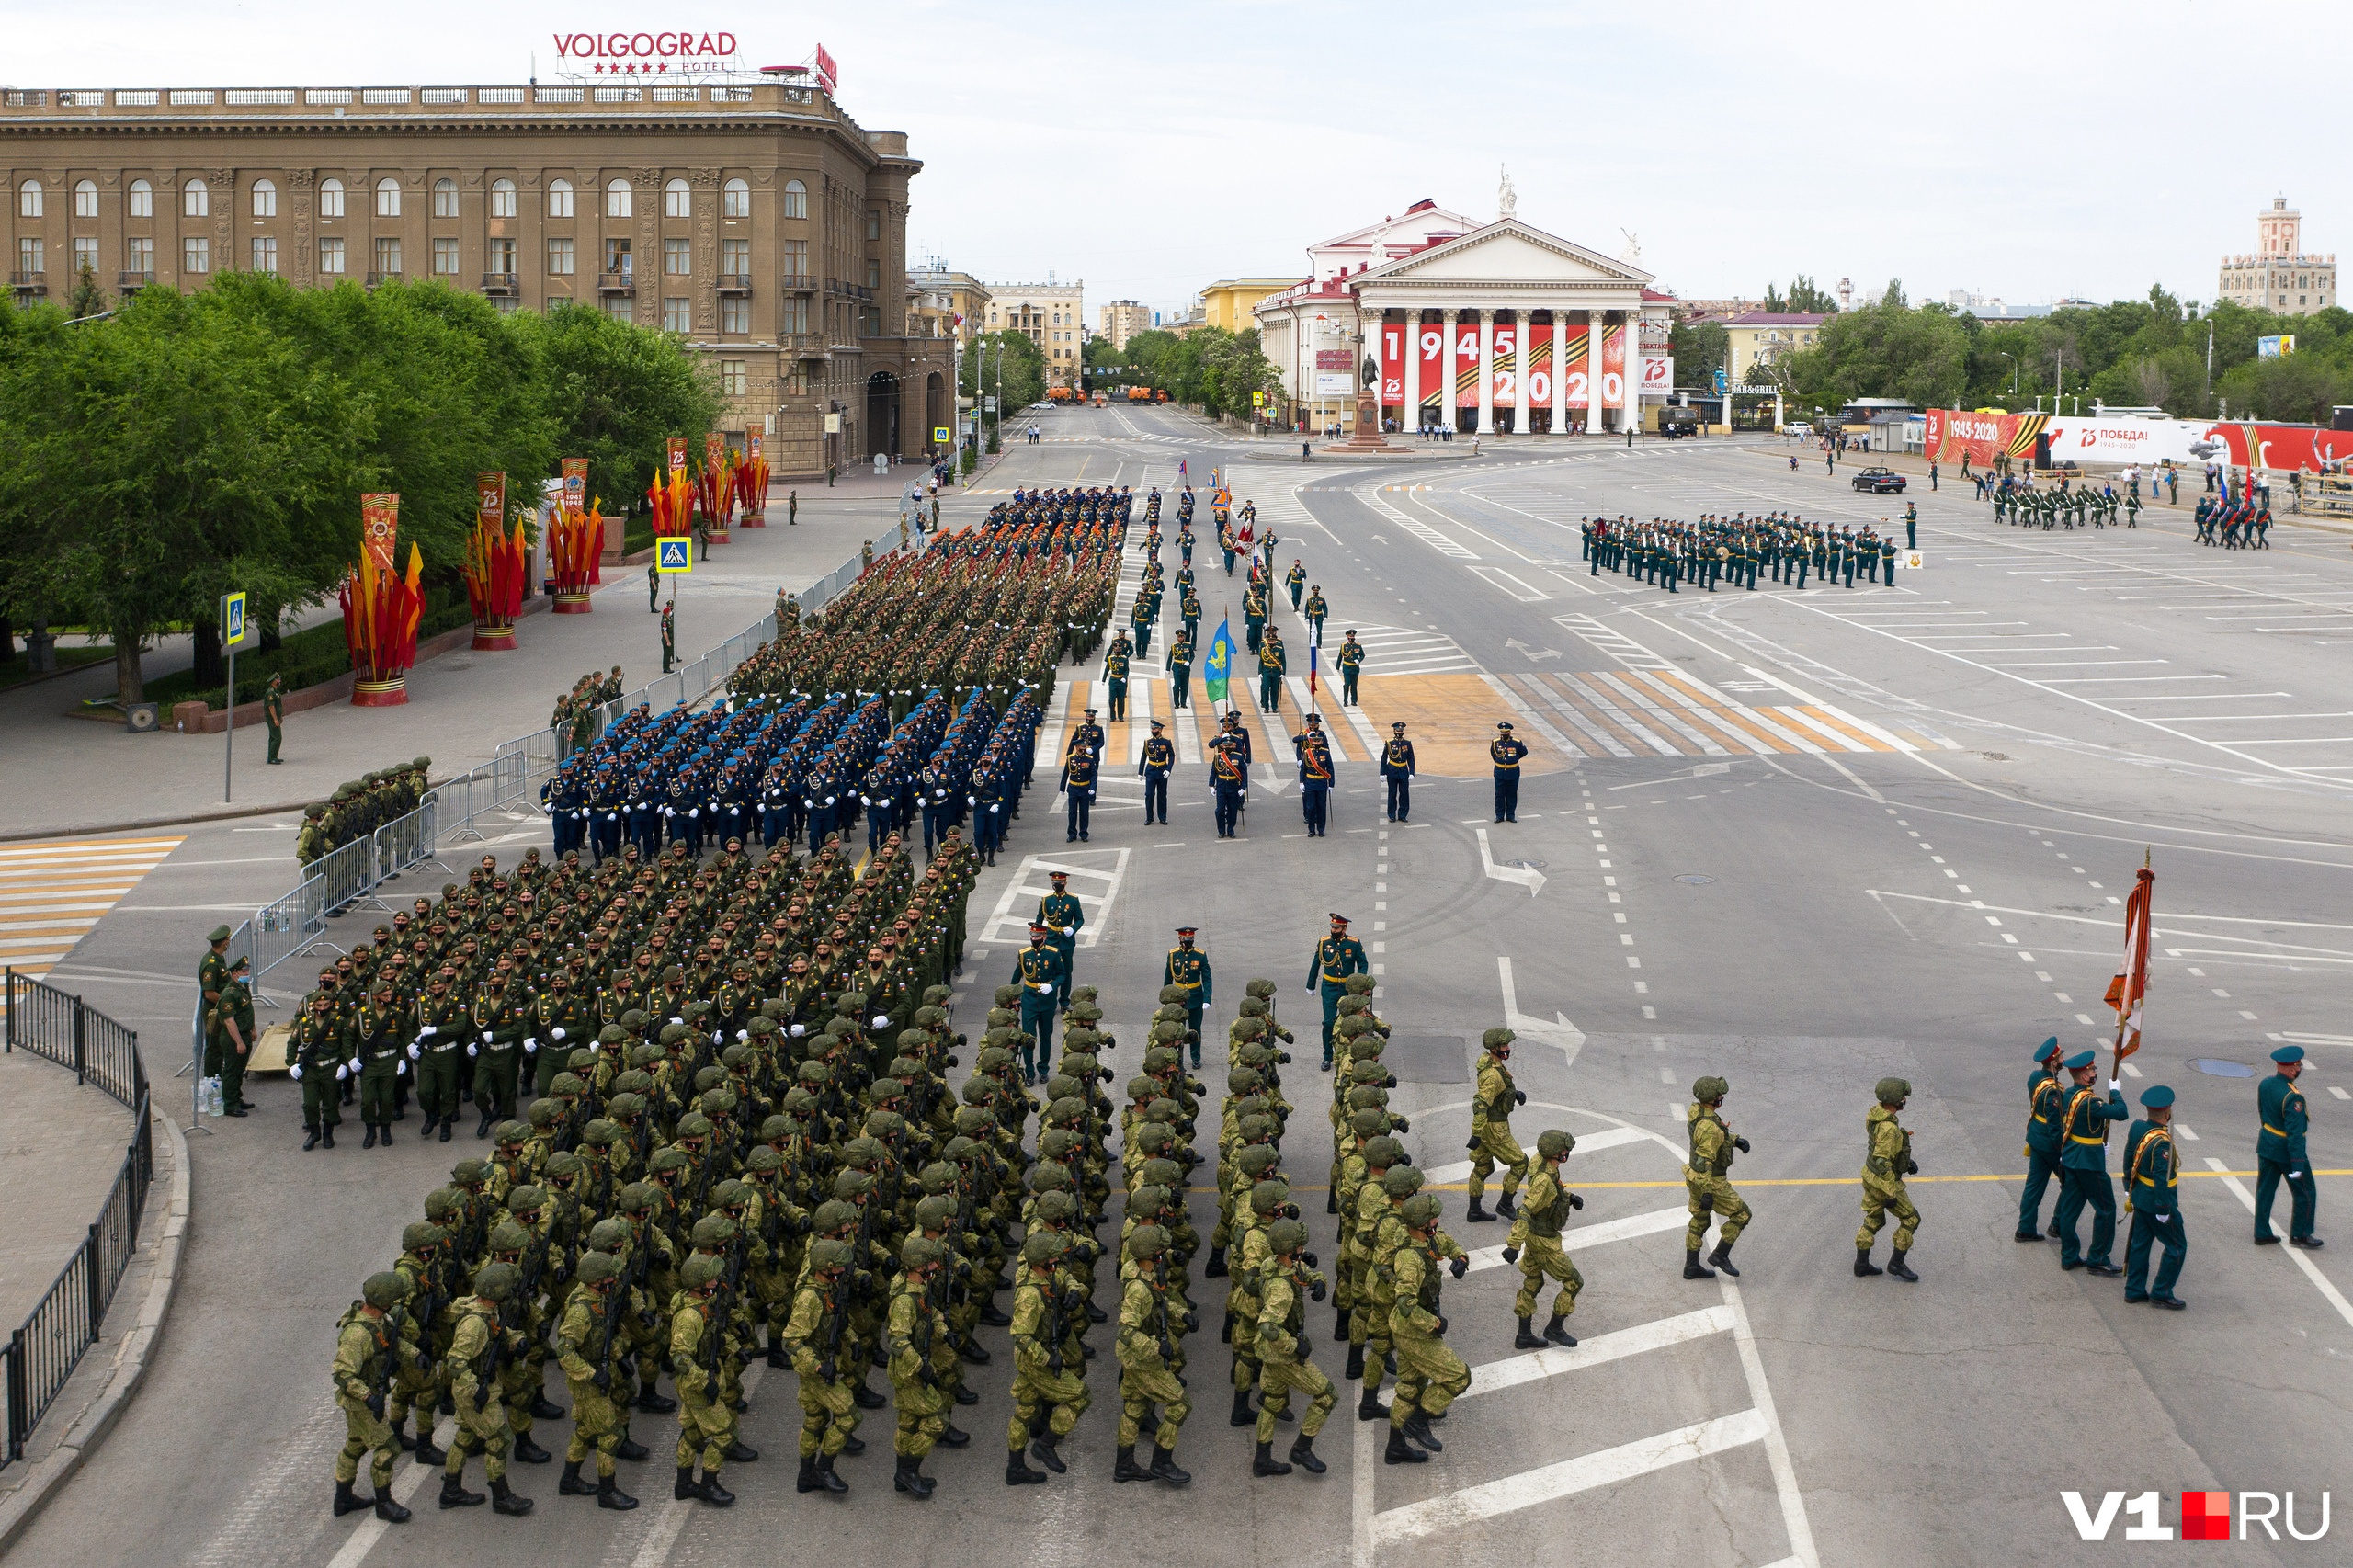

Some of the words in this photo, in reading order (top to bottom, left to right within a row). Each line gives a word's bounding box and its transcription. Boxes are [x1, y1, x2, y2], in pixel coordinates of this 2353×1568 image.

[553, 32, 736, 58] VOLGOGRAD
[682, 62, 727, 72] HOTEL
[1644, 358, 1666, 381] 75
[1949, 419, 1998, 441] 1945-2020
[2080, 427, 2097, 448] 75
[2100, 429, 2148, 441] ПОБЕДА!
[2099, 441, 2136, 449] 1945–2020
